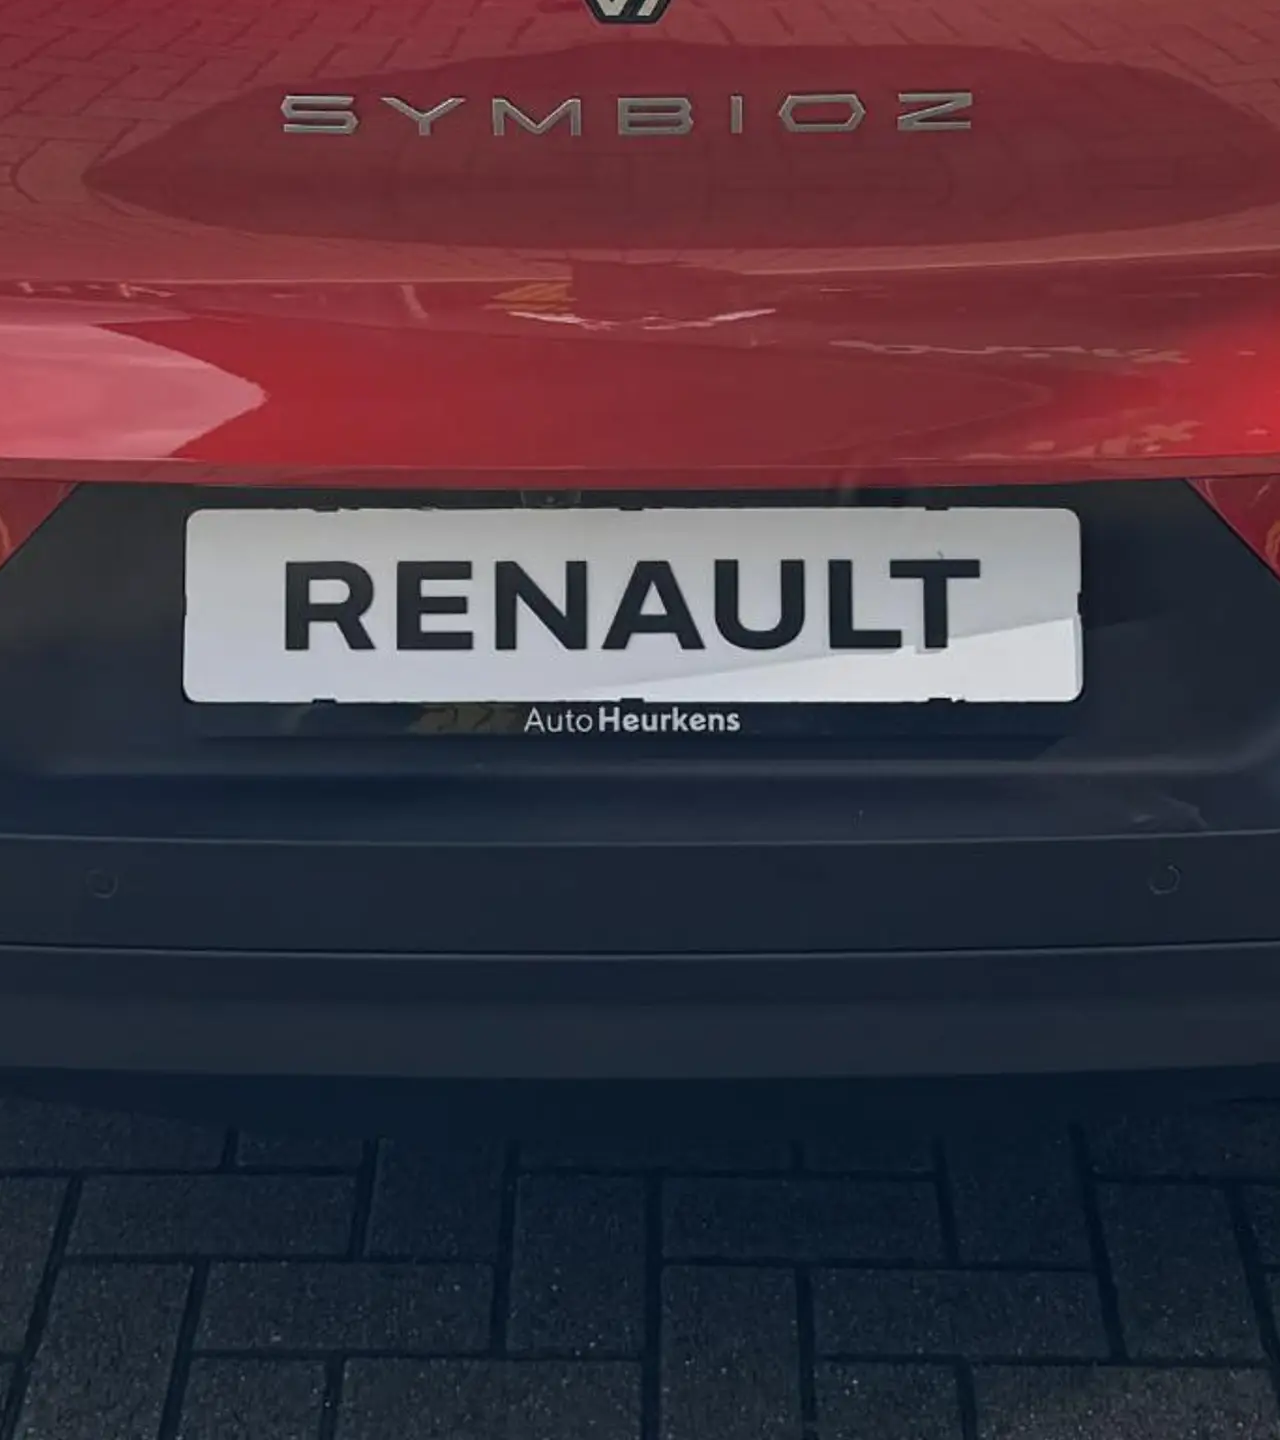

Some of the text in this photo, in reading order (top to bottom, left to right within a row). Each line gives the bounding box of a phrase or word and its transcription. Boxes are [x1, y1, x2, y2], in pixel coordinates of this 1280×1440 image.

[281, 91, 973, 137] SYMBIOZ
[283, 558, 981, 651] RENAULT
[524, 706, 741, 733] Auto Heurkens
